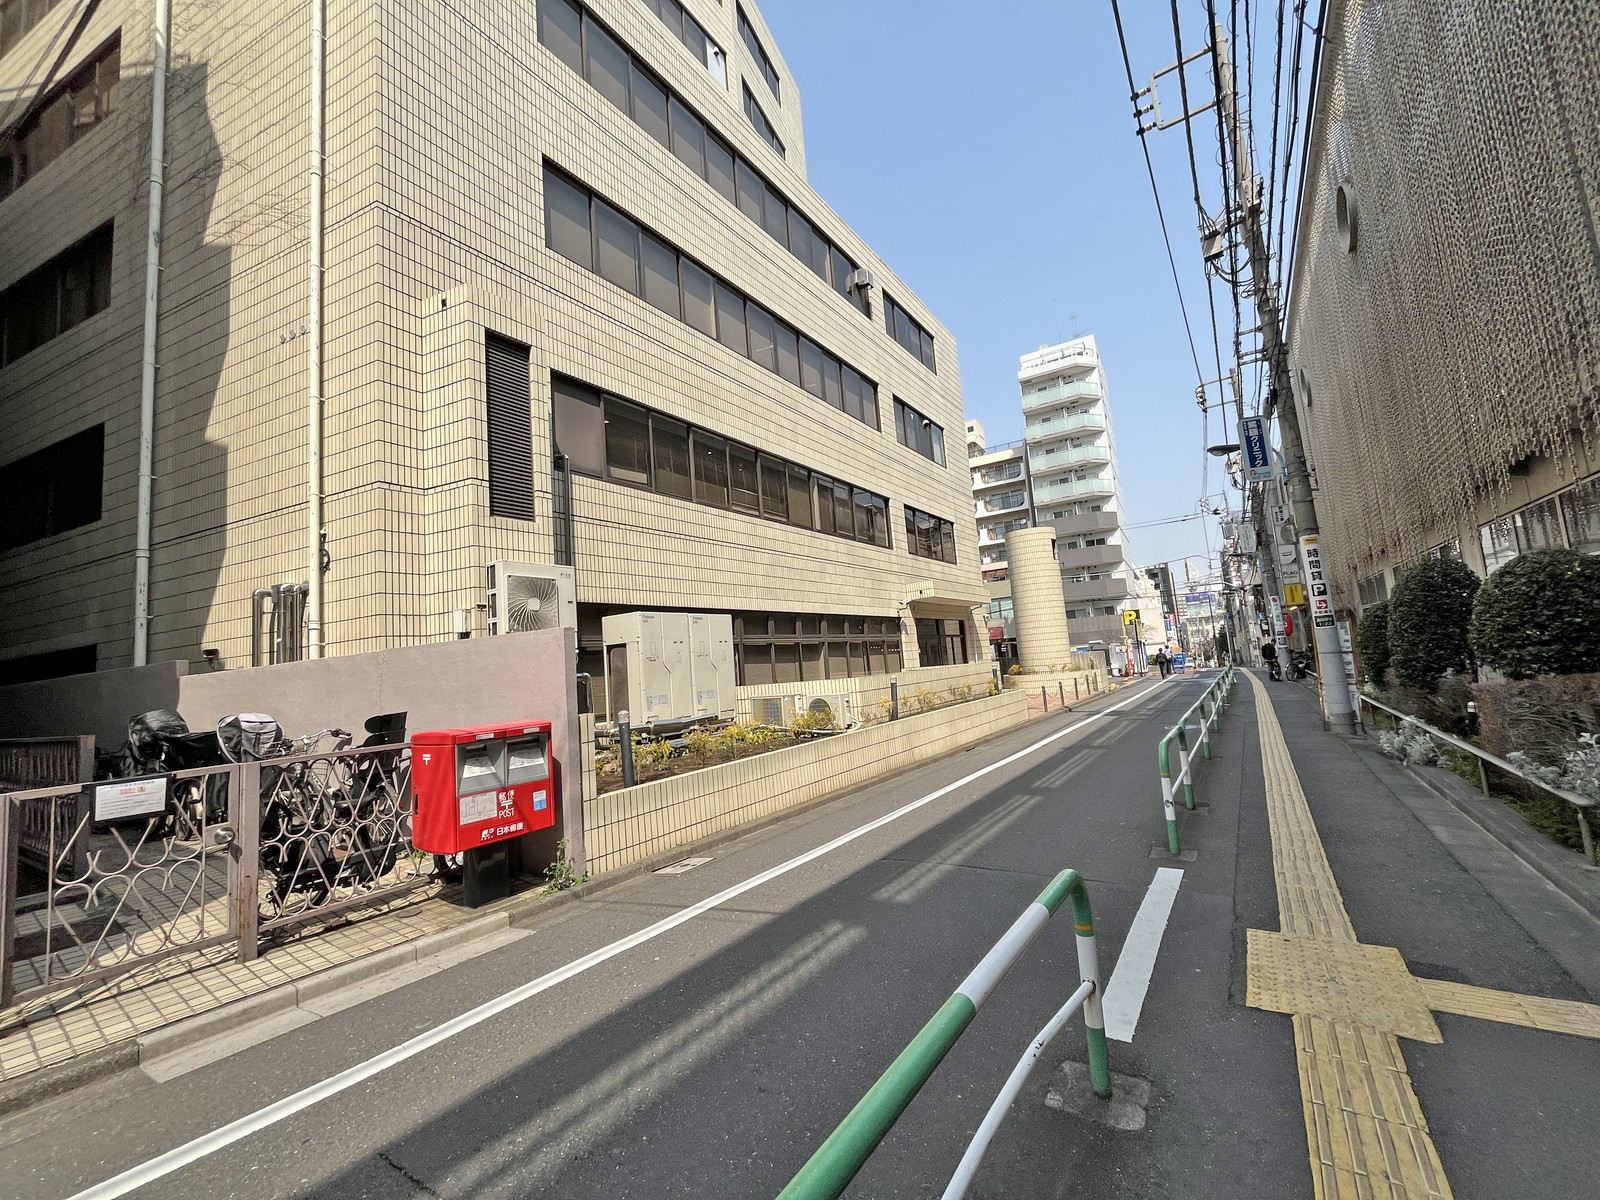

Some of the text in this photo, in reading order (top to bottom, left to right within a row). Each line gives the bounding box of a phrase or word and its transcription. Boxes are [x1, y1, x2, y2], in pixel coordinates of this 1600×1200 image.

[1306, 548, 1324, 581] 時間貸
[1123, 610, 1137, 625] P
[499, 790, 515, 802] 郵便
[498, 807, 515, 819] POST
[496, 822, 525, 836] 日本郵便
